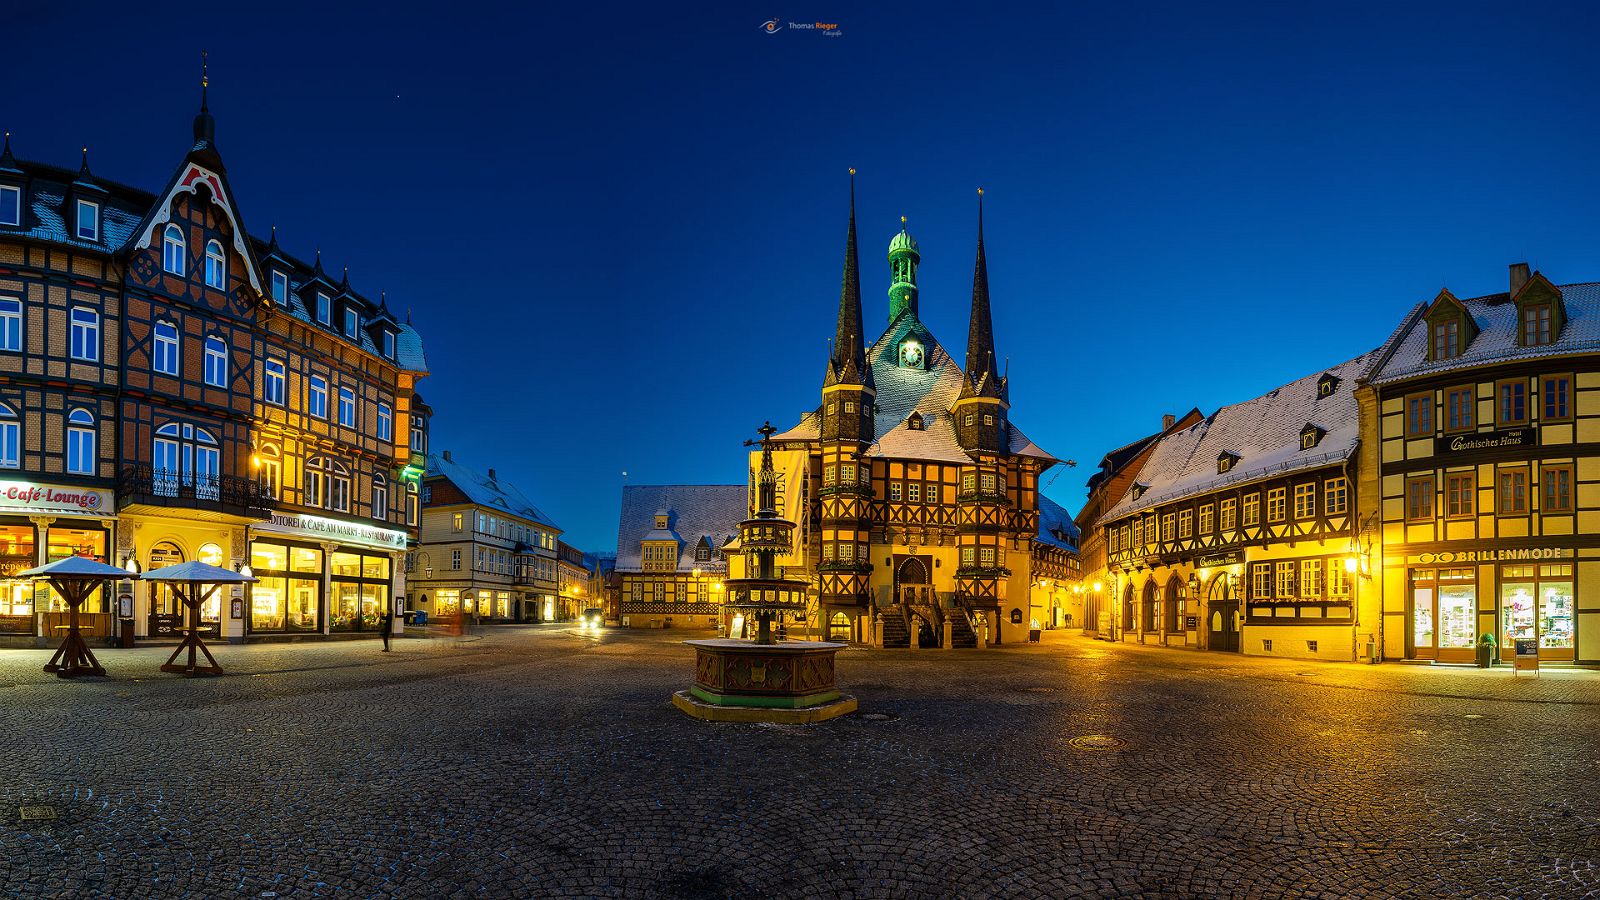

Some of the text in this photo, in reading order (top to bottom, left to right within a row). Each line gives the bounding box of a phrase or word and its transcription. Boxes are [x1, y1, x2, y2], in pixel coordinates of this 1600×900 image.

[1451, 436, 1522, 451] Gothisches Haus
[301, 518, 307, 529] &
[326, 524, 336, 533] AM
[336, 525, 358, 537] MARKT
[361, 529, 396, 542] RESTAURANT
[1458, 548, 1561, 561] BRILLENMODE
